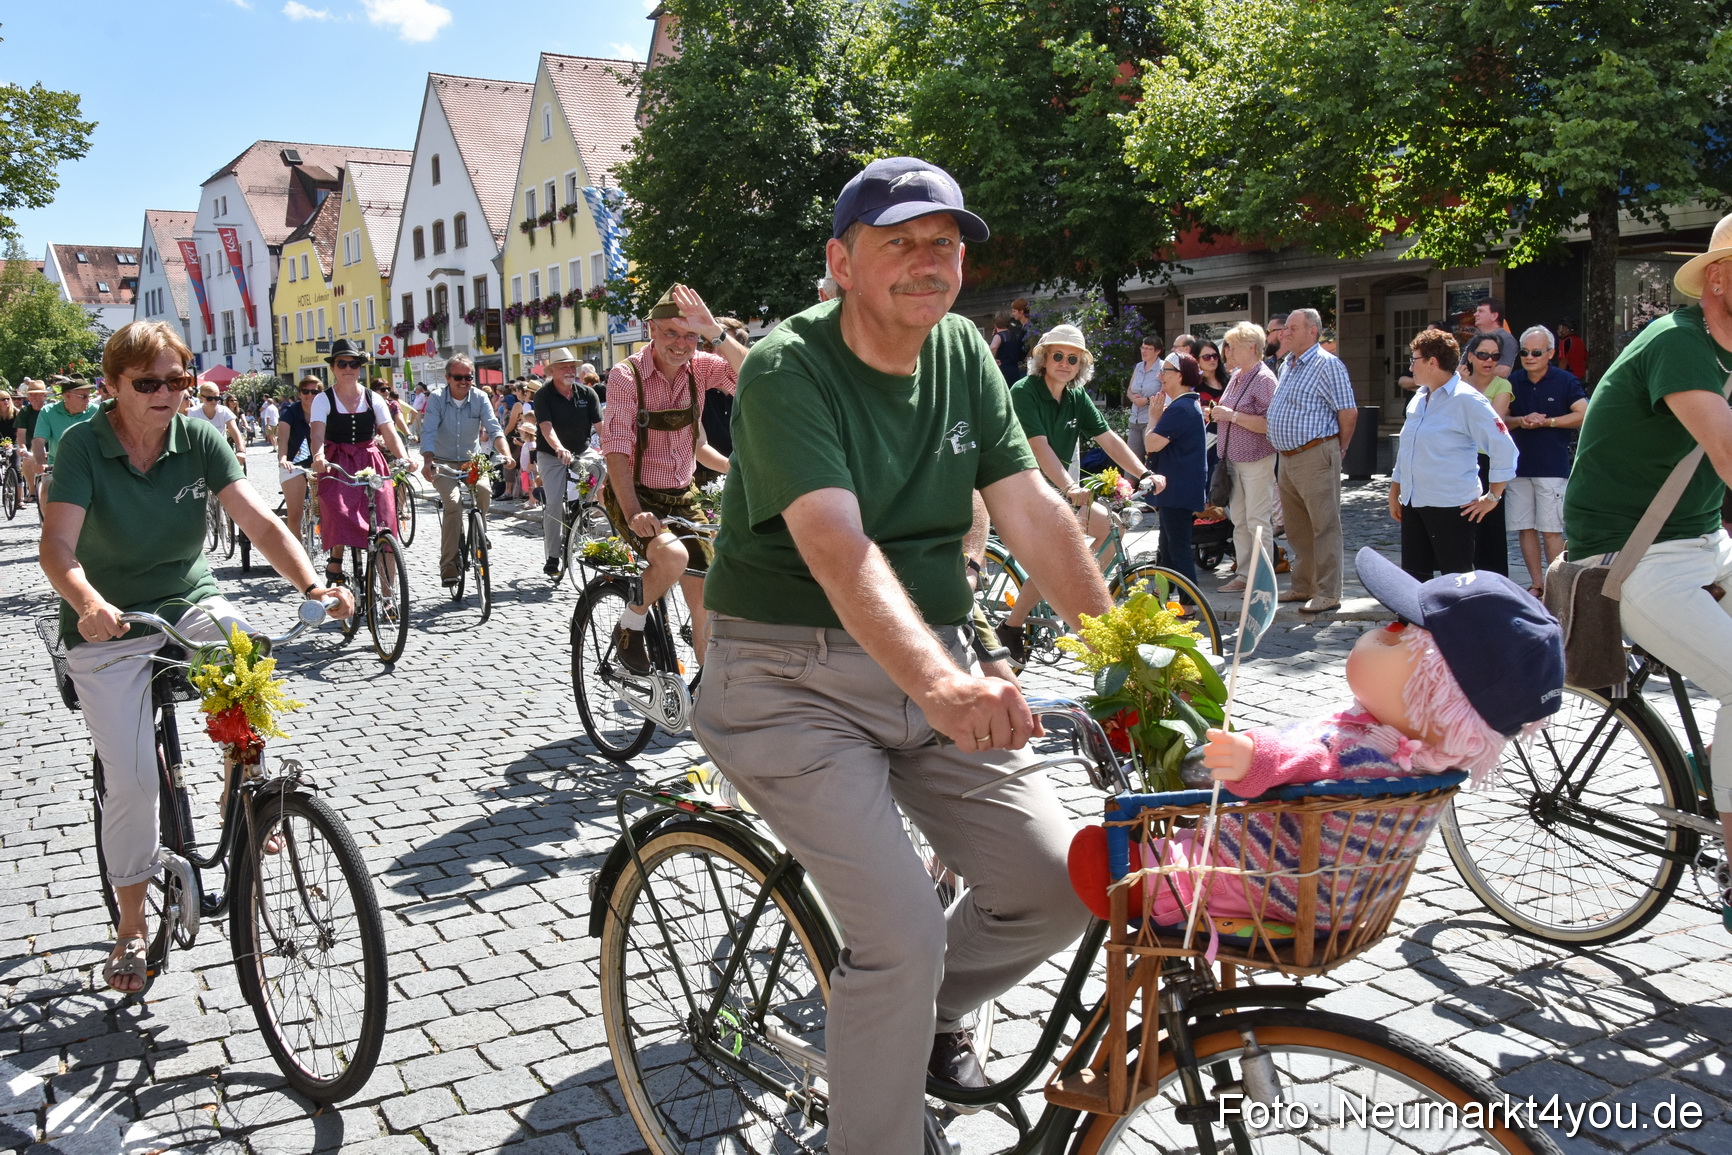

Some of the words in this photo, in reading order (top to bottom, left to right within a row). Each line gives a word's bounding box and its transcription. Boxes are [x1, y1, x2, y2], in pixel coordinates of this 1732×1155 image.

[223, 230, 238, 252] K&L
[297, 293, 311, 307] HOTEL
[300, 355, 319, 364] Restaurant
